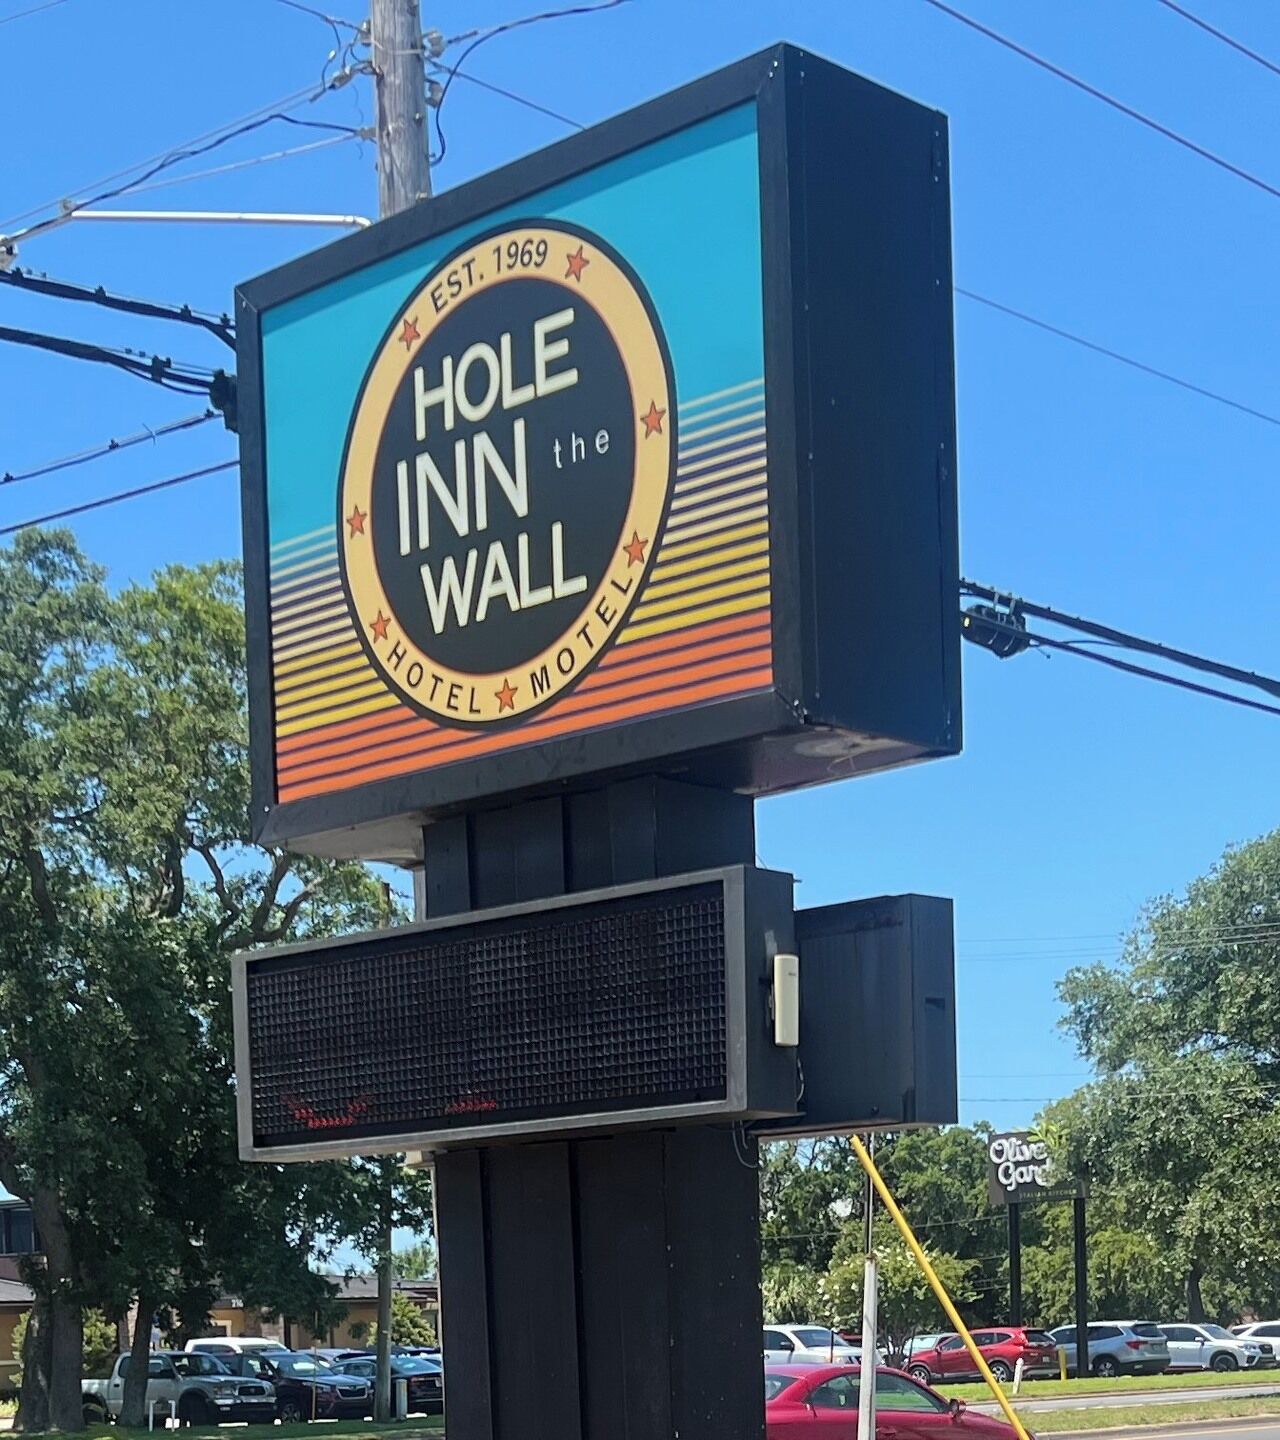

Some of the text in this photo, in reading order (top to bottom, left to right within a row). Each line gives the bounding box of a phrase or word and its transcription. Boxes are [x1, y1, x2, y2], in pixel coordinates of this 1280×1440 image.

[430, 238, 549, 313] EST. 1969
[414, 307, 578, 441] HOLE
[397, 417, 610, 556] INN the
[420, 520, 588, 635] WALL
[387, 640, 481, 714] HOTEL
[530, 576, 634, 698] MOTEL
[989, 1137, 1048, 1164] Olive
[998, 1158, 1055, 1192] Gard
